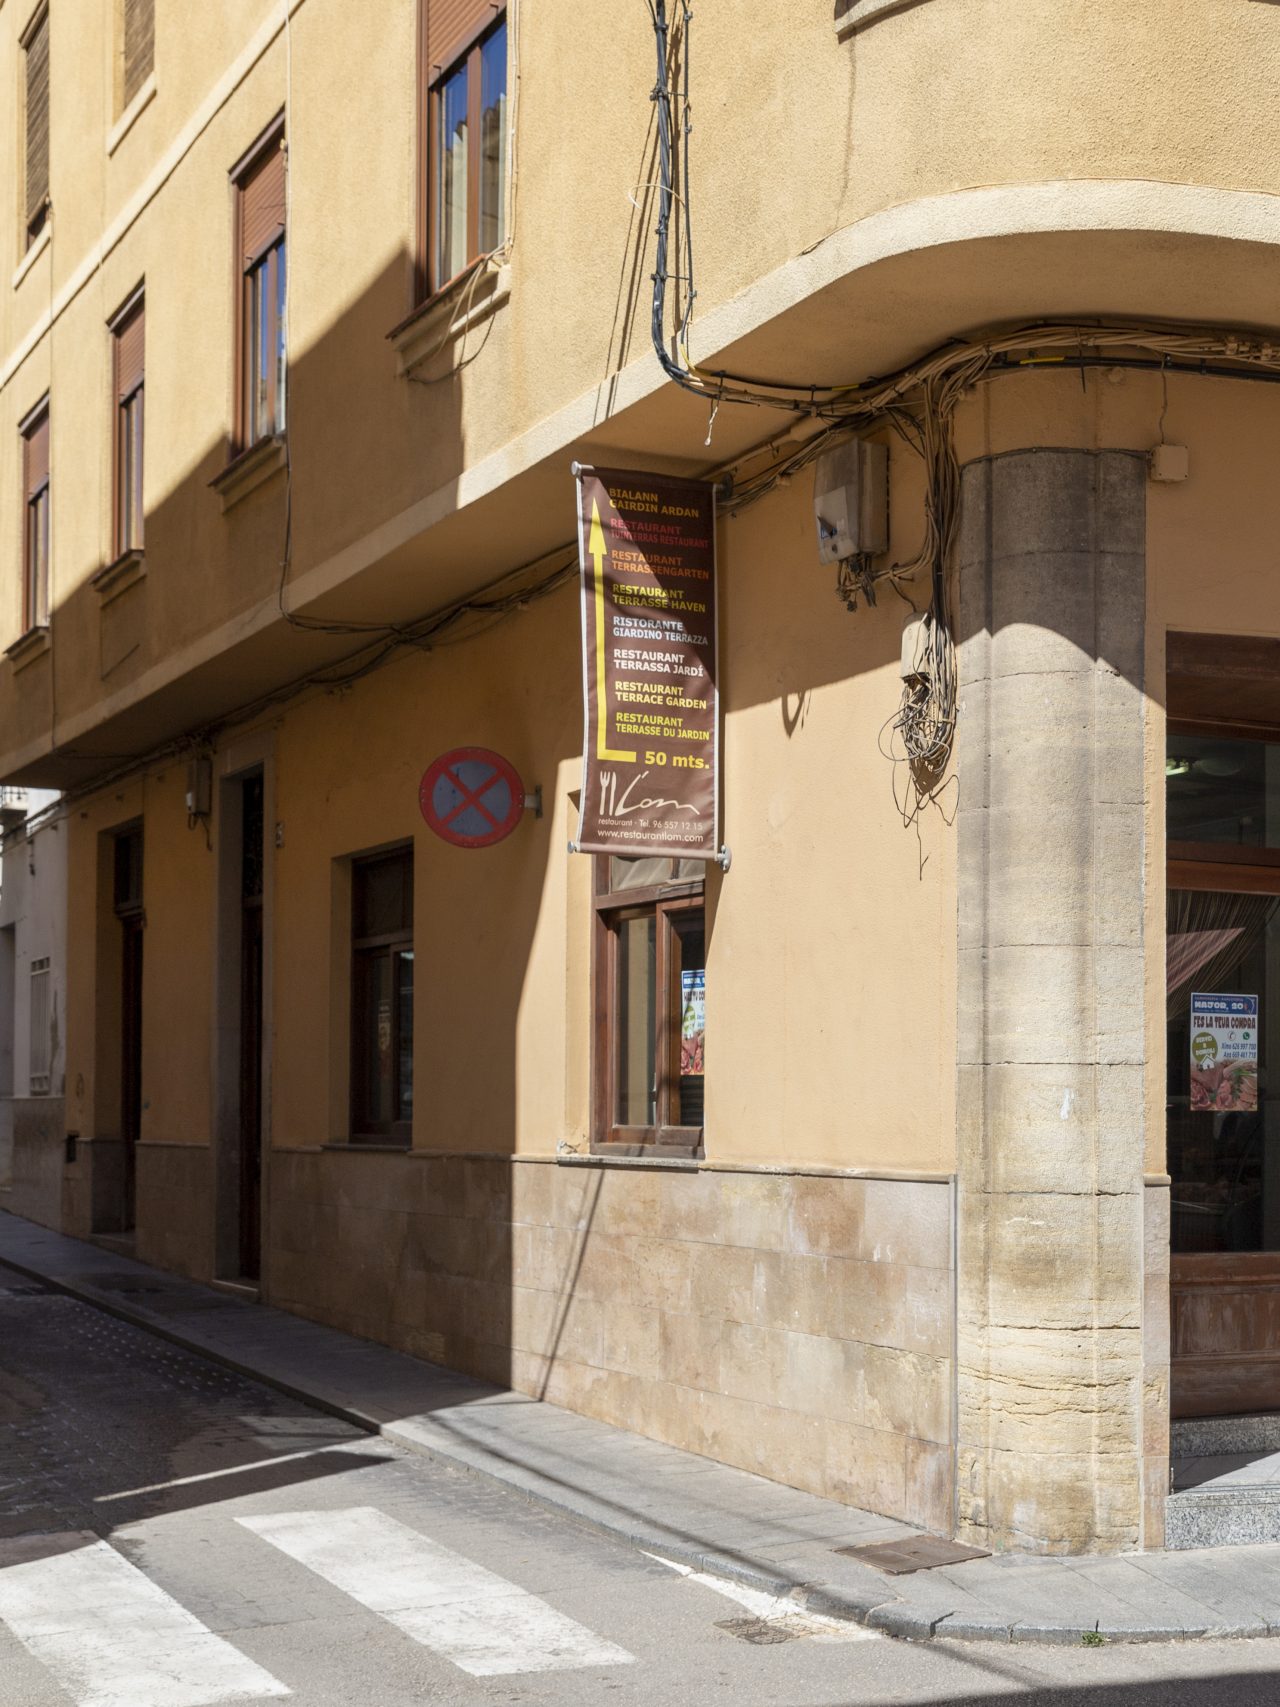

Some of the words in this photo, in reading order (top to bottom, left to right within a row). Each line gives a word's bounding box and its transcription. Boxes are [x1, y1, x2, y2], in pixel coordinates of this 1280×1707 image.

[609, 488, 658, 502] BIALANN
[609, 499, 658, 513] GAIRDIN
[661, 505, 699, 518] ARDAN
[610, 518, 682, 535] RESTAURANT
[660, 535, 708, 549] RESTAURANT
[611, 550, 683, 565] RESTAURANT
[612, 560, 710, 580] TERRASSENGARTEN
[613, 584, 684, 600] RESTAURANT
[612, 594, 669, 609] TERRASSE
[671, 600, 706, 613] HAVEN
[613, 616, 684, 631] RISTORANTE
[613, 627, 663, 640] GIARDINO
[665, 631, 708, 646] TERRAZZA
[614, 649, 685, 664] RESTAURANT
[613, 659, 671, 673] TERRASSA
[673, 664, 704, 677] JARDÍ
[615, 681, 684, 696] RESTAURANT
[615, 691, 664, 705] TERRACE
[666, 697, 707, 710] GARDEN
[616, 712, 684, 727] RESTAURANT
[616, 723, 661, 736] TERRASSE
[663, 727, 675, 737] DU
[677, 728, 710, 740] JARDIN
[644, 751, 667, 766] 50
[672, 754, 710, 769] mts.
[598, 818, 633, 827] restaurant
[639, 819, 651, 828] Tel.
[653, 821, 662, 829] 96
[664, 821, 679, 829] 557
[681, 822, 690, 830] 12
[693, 822, 703, 831] 15
[597, 829, 704, 842] www.restaurantlom.com
[1193, 1016, 1204, 1028] FES
[1206, 1016, 1213, 1028] LA
[1215, 1016, 1229, 1029] TEVA
[1231, 1017, 1256, 1029] COMPRA
